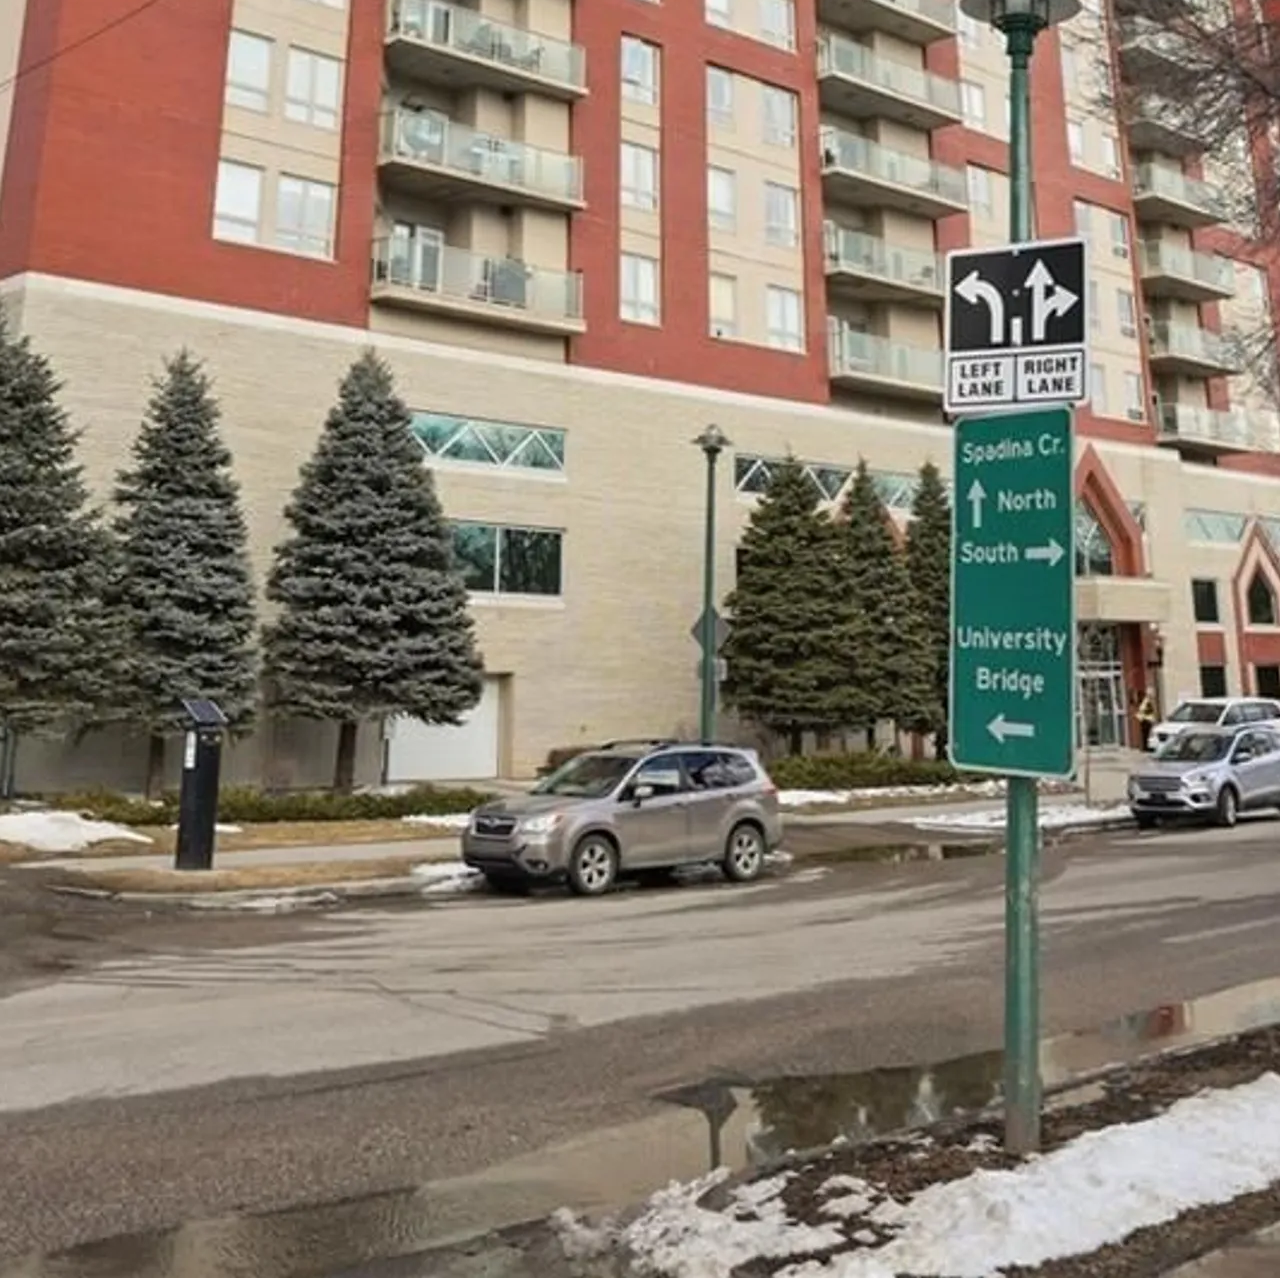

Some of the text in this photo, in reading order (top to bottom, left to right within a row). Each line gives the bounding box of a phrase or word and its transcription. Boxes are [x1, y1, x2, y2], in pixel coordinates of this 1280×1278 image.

[960, 362, 1001, 379] LEFT
[1024, 356, 1077, 374] RIGHT
[958, 380, 1004, 398] LANE
[1027, 376, 1075, 394] LANE
[962, 433, 1065, 466] Spadina Cr.
[997, 488, 1057, 512] North
[961, 541, 1019, 564] South
[957, 626, 1067, 657] University
[976, 666, 1045, 700] Bridge
